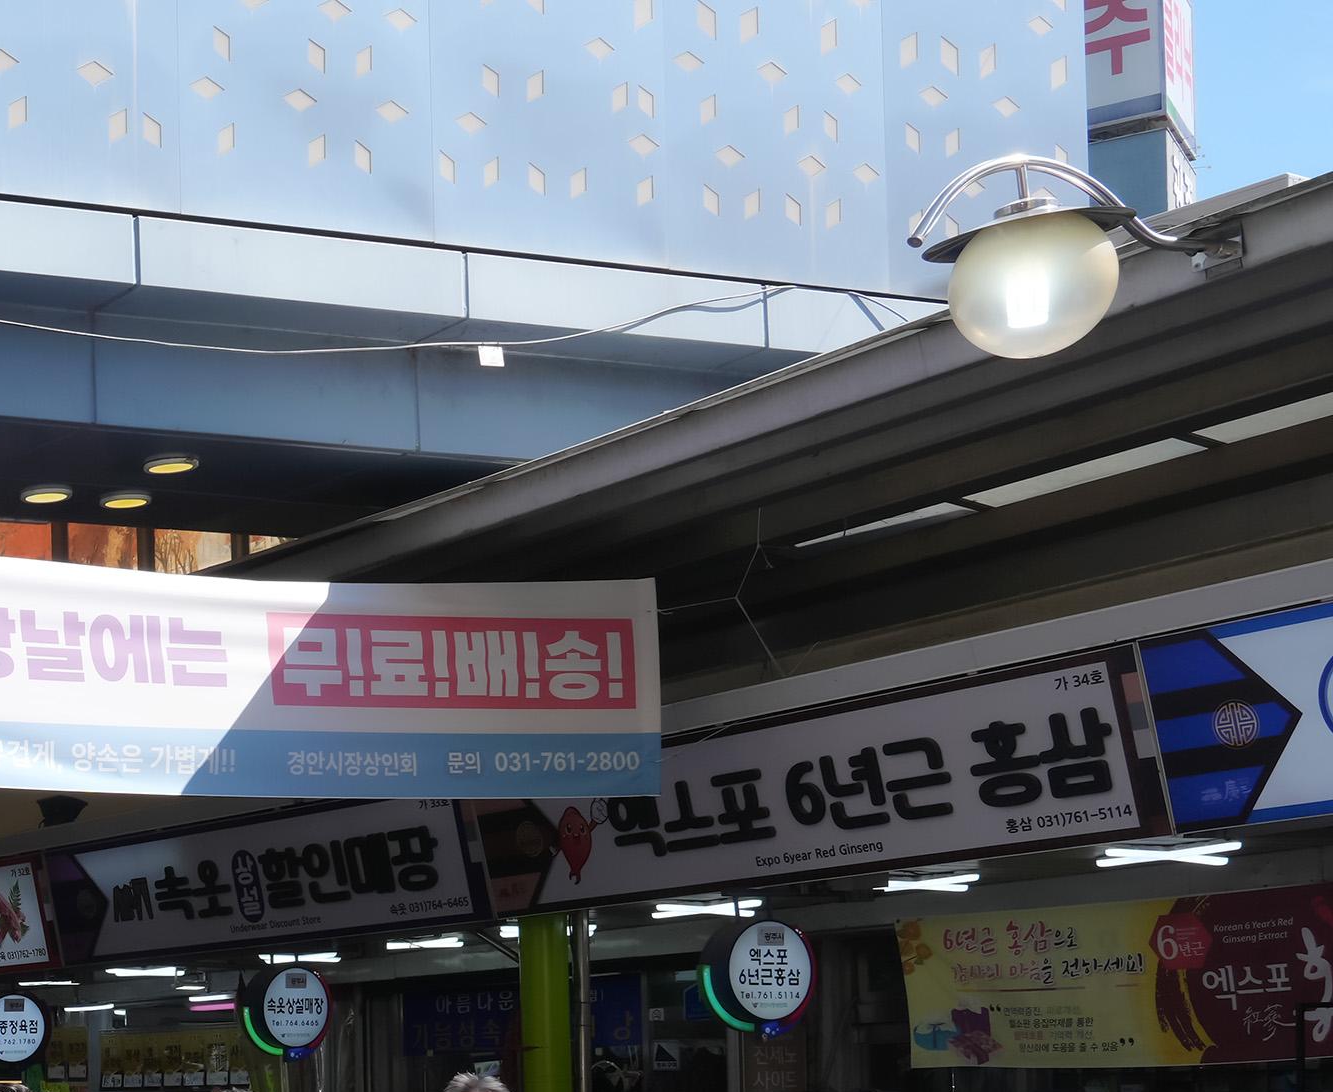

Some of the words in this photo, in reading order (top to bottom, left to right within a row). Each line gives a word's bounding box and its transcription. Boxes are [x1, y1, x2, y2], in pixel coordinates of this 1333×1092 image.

[279, 624, 625, 705] 무!료!배!송!
[1053, 671, 1071, 692] 가
[1073, 668, 1106, 689] 34호
[71, 743, 143, 774] 양손은
[150, 745, 236, 777] 가볍게!!
[286, 750, 418, 778] 경안시장상인회
[446, 750, 481, 776] 문의
[494, 750, 641, 774] 031-761-2800
[606, 768, 776, 857] 엑스포
[784, 737, 952, 831] 6년근
[969, 705, 1114, 806] 홍삼
[1005, 815, 1033, 835] 홍삼
[755, 853, 780, 869] Expo
[782, 849, 813, 866] 6year
[815, 846, 836, 861] Red
[838, 839, 884, 860] Ginseng
[1213, 922, 1243, 933] Korean
[1277, 917, 1294, 927] Red
[1222, 933, 1257, 944] Ginseng
[1258, 931, 1288, 941] Extract
[749, 948, 789, 966] 엑스포
[738, 967, 801, 987] 6년근홍삼
[1201, 963, 1293, 1011] 엑스포
[267, 997, 325, 1015] 속옷상설매장
